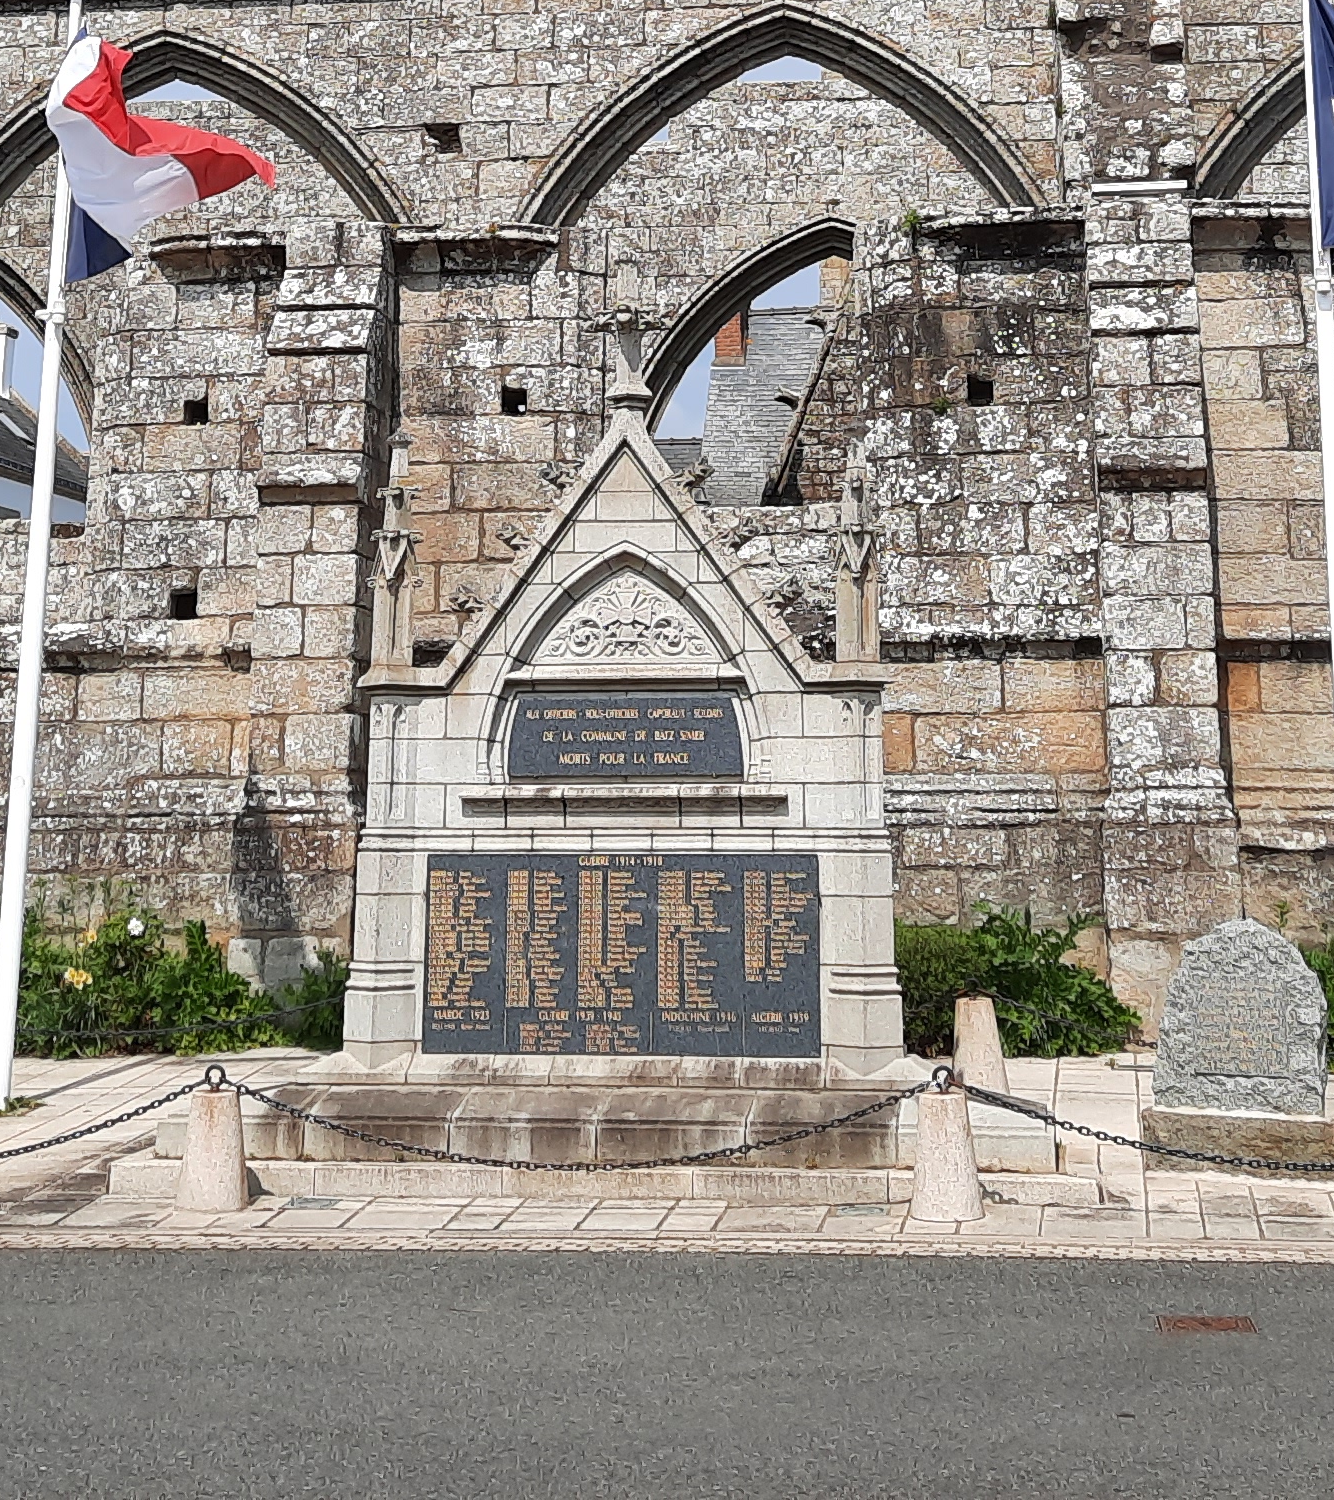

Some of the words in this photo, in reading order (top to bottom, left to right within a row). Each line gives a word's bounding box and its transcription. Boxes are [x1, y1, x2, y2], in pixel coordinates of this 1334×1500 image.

[542, 730, 554, 742] DE
[562, 730, 574, 742] LA
[580, 730, 627, 742] COMMUNE
[635, 730, 648, 741] DE
[558, 752, 591, 765] MORTS
[599, 752, 626, 765] POUR
[633, 752, 645, 765] LA
[653, 752, 689, 765] FRANCE
[578, 855, 610, 866] GUERRE
[615, 855, 635, 866] 1914
[661, 1011, 711, 1022] INDOCHINE
